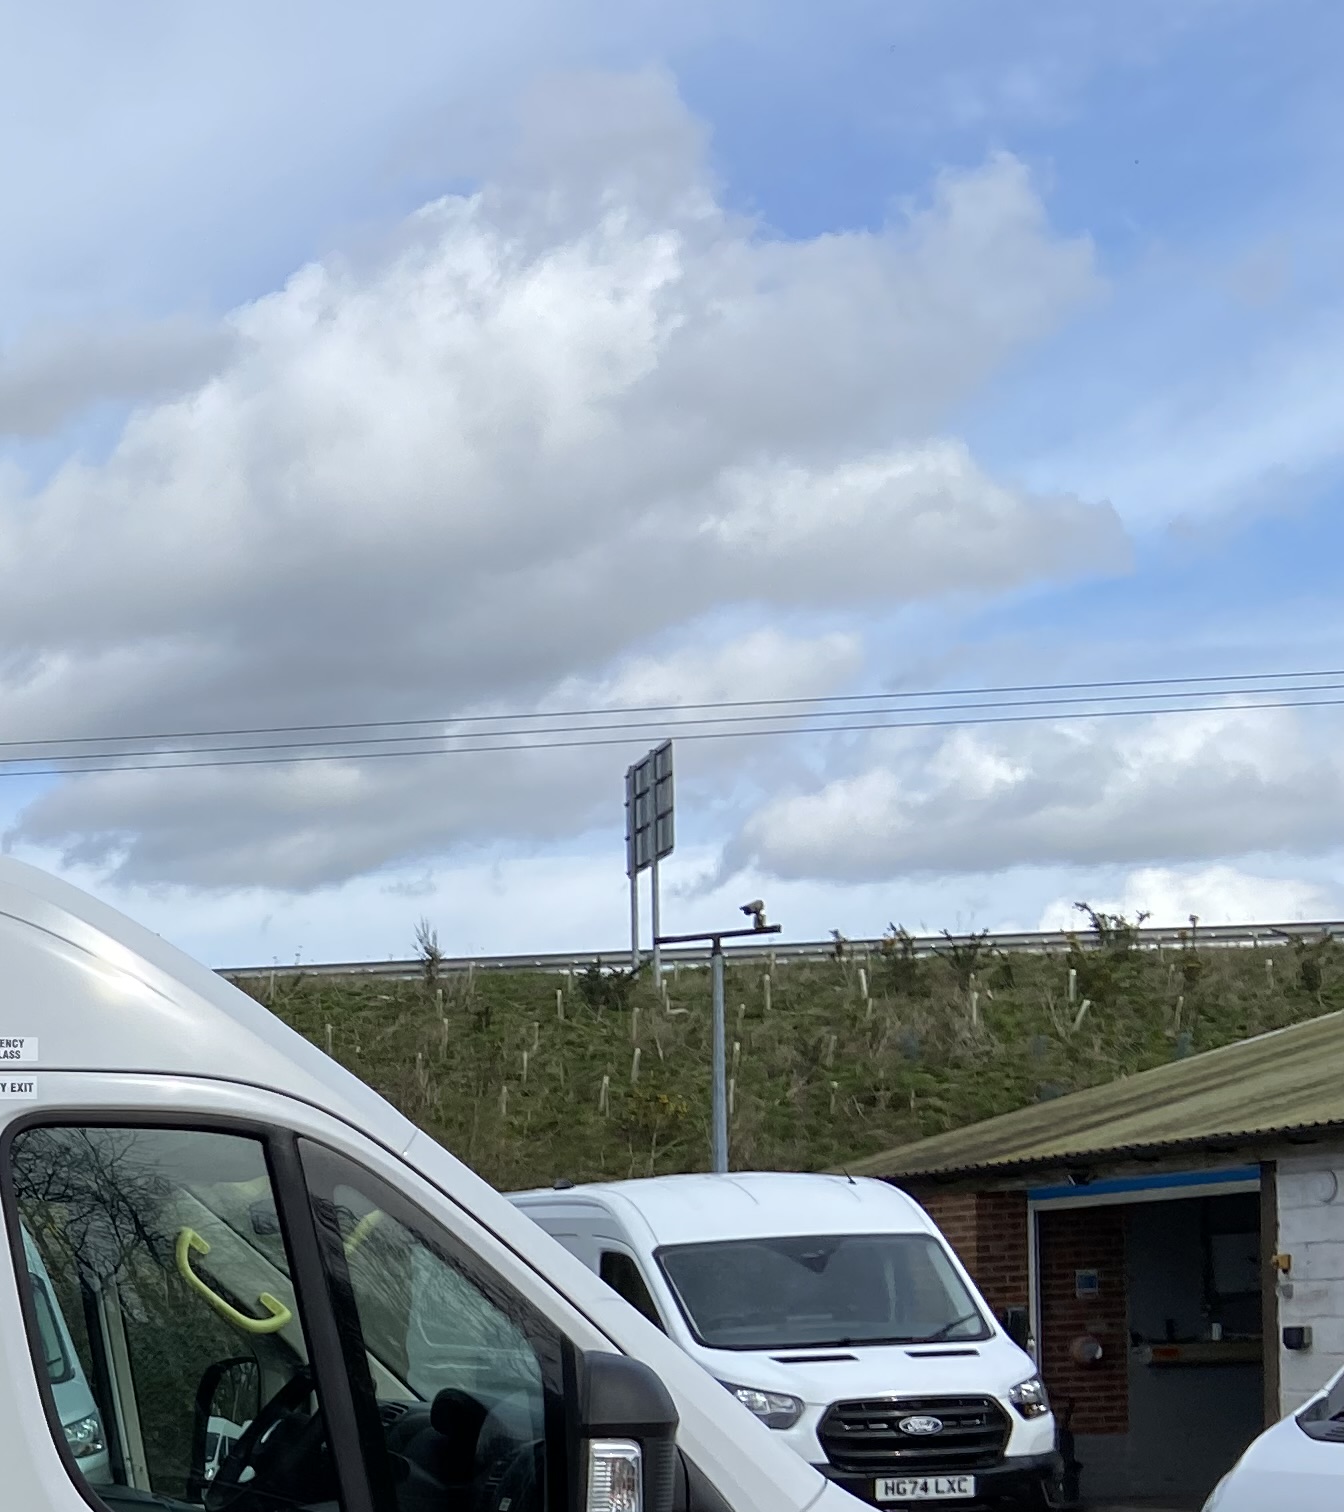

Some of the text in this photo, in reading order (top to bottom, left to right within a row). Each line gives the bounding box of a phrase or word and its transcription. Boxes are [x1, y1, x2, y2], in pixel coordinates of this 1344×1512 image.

[10, 1082, 34, 1093] EXIT
[884, 1476, 968, 1496] HG74 LXC
